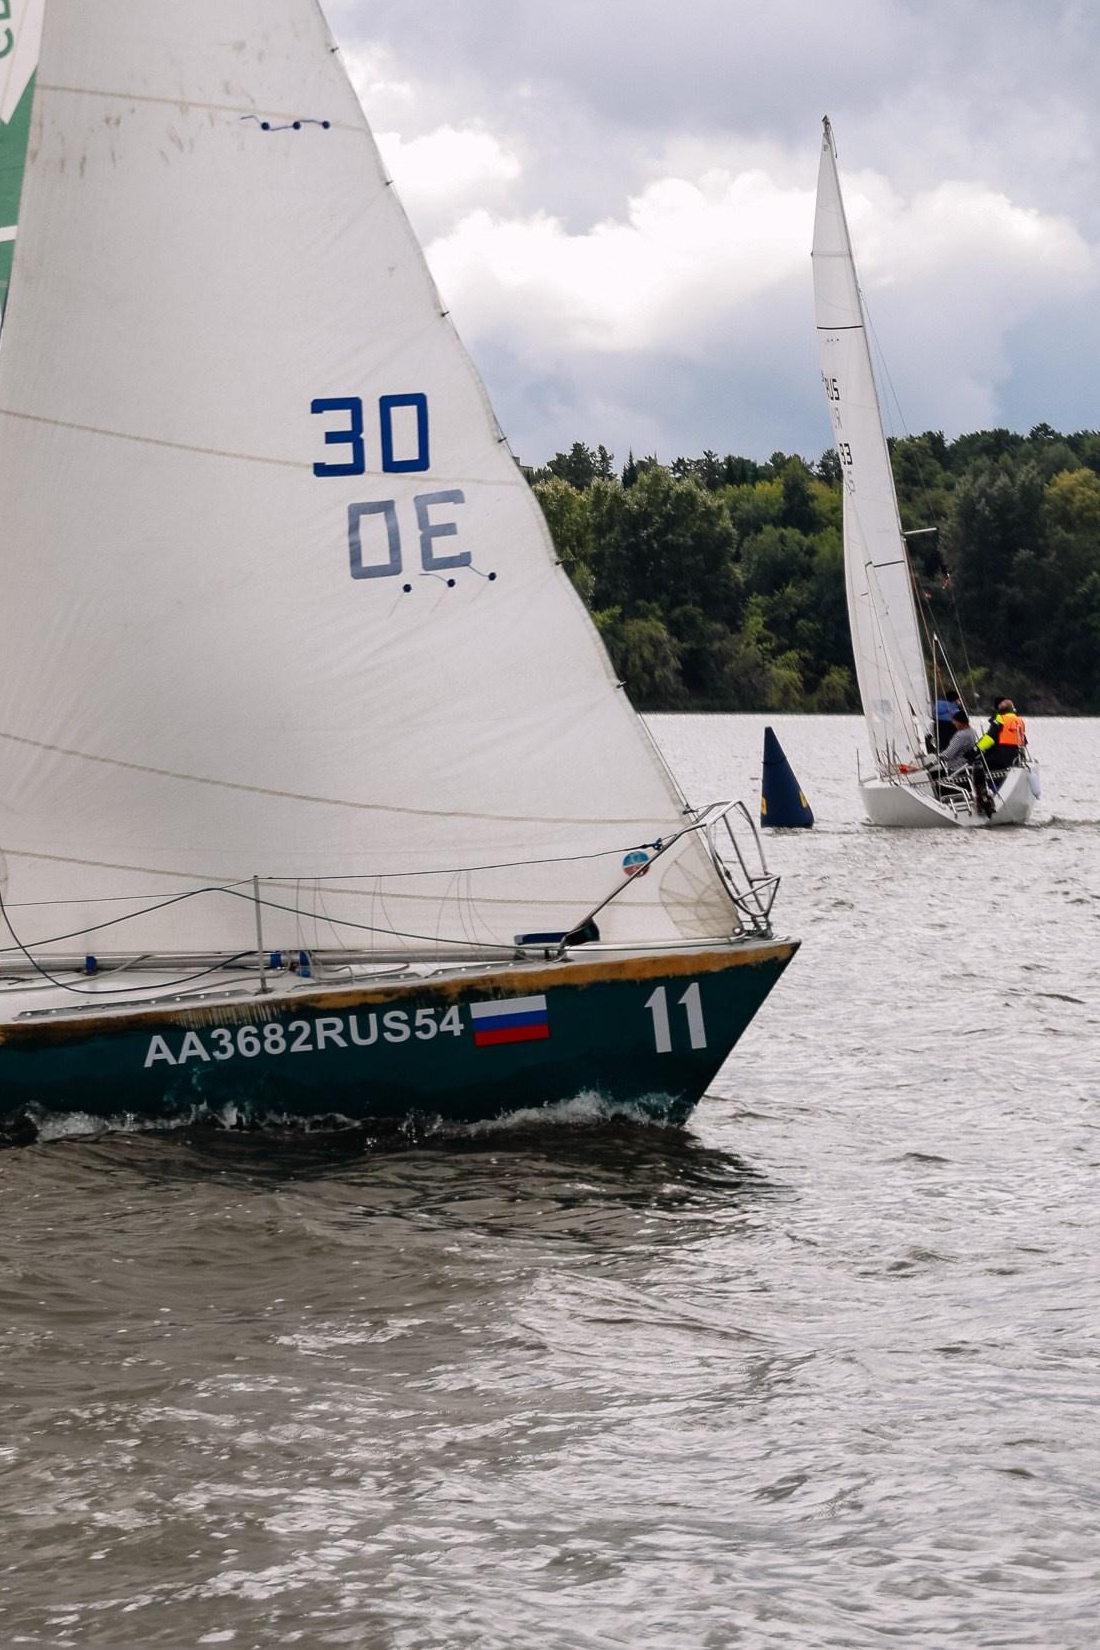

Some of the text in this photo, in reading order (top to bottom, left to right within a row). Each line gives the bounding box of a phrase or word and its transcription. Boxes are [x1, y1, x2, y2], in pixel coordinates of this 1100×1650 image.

[310, 392, 431, 478] 30
[143, 1005, 465, 1068] AA3682RUS54
[644, 982, 707, 1053] 11
